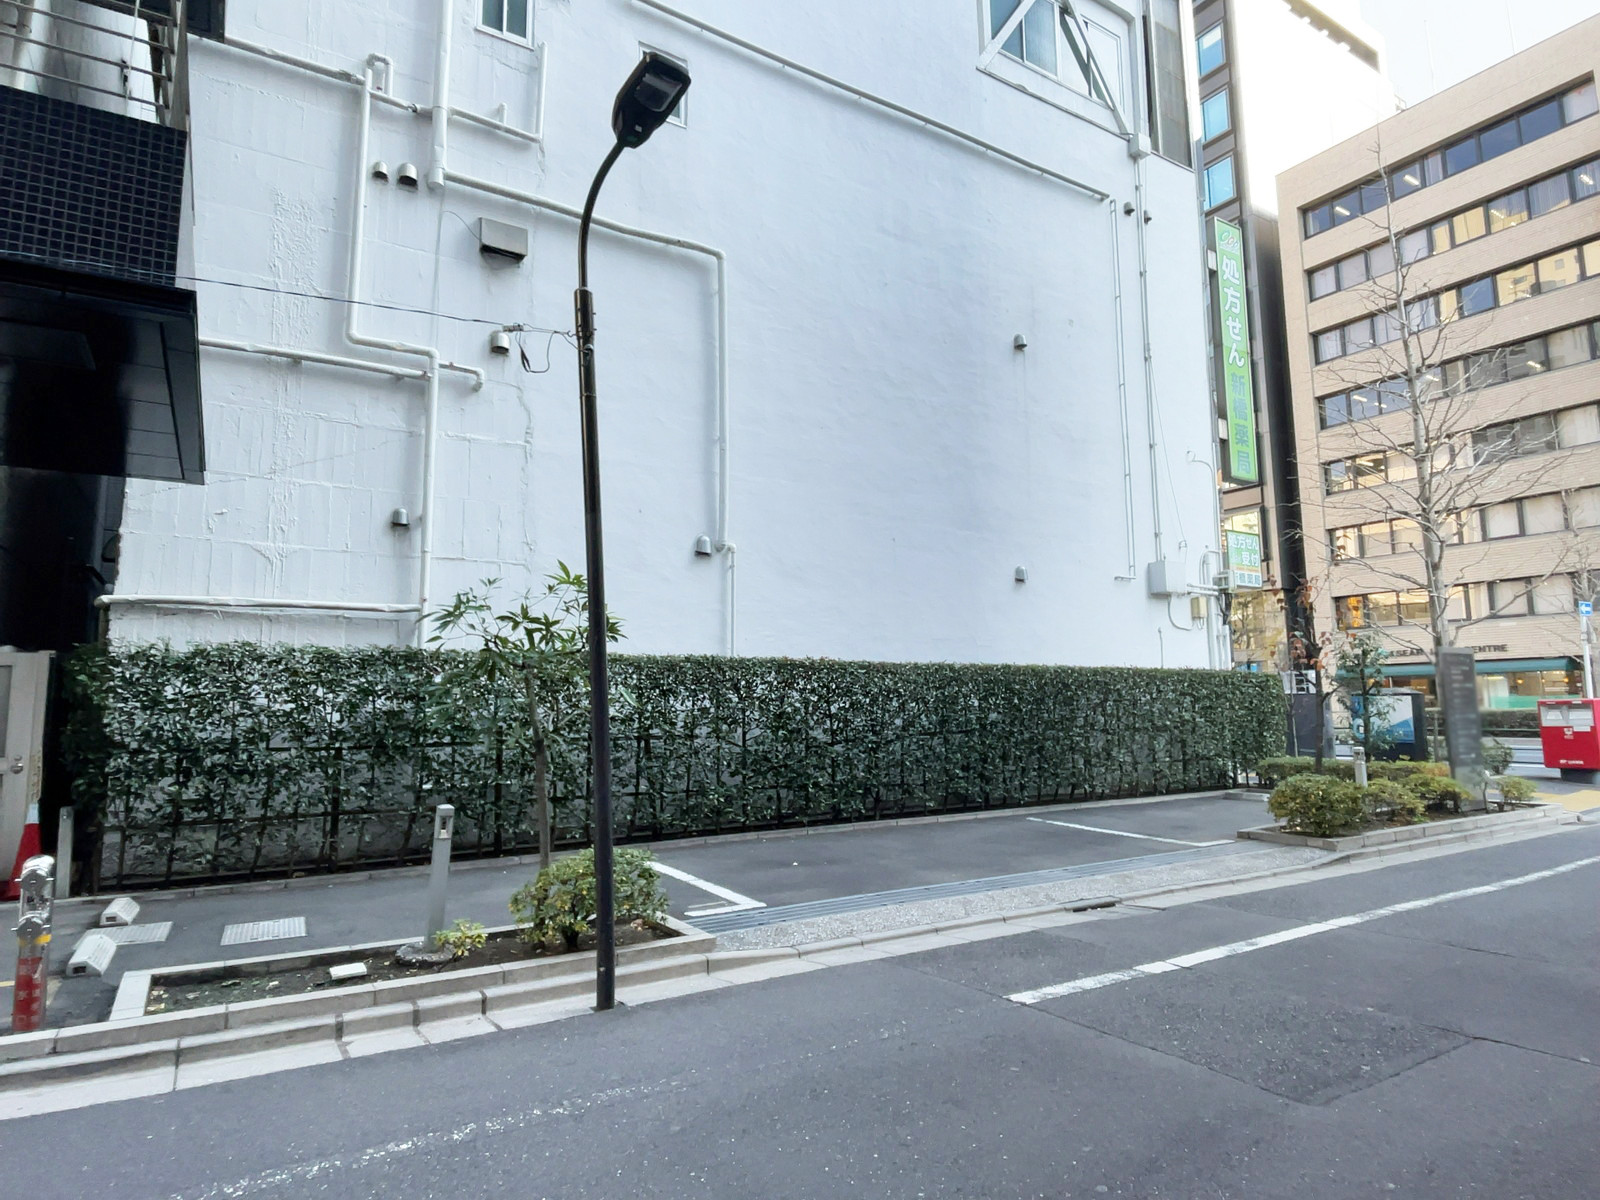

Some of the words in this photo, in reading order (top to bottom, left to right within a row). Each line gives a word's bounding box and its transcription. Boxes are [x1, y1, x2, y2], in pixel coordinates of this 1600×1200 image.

[1221, 254, 1245, 367] 処方せん
[1228, 534, 1259, 550] 処方せん
[1465, 644, 1508, 654] ENTRE
